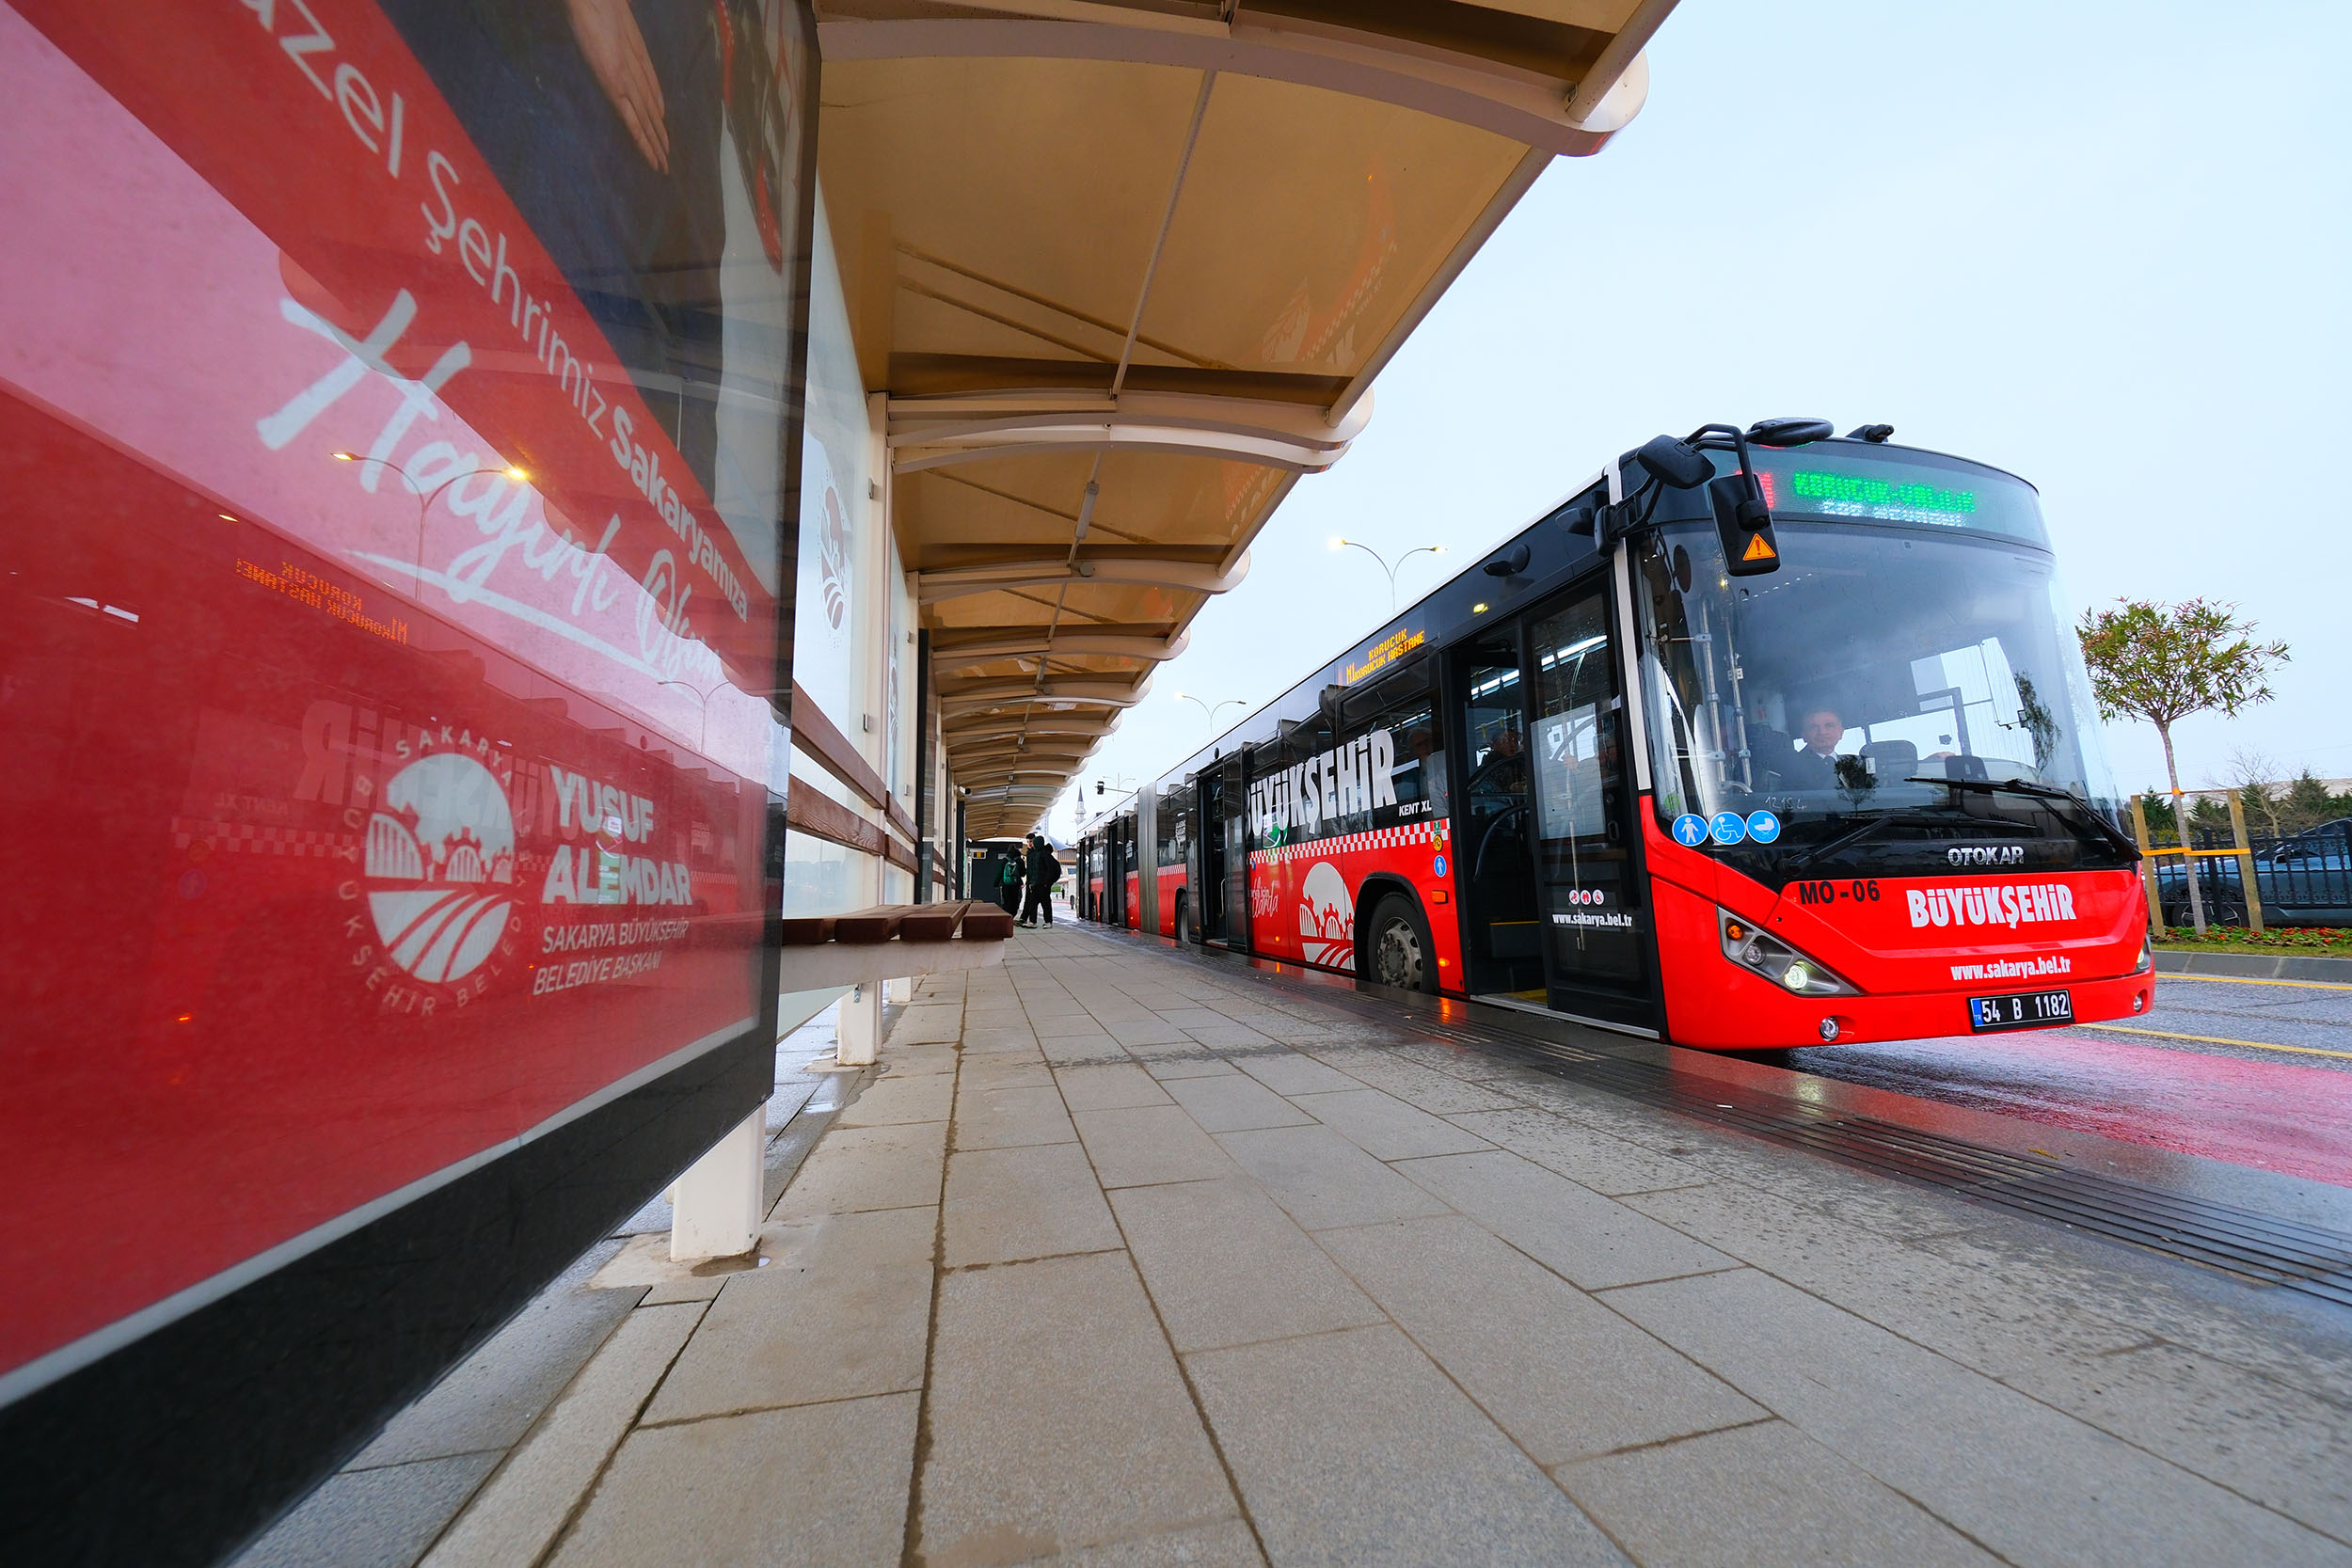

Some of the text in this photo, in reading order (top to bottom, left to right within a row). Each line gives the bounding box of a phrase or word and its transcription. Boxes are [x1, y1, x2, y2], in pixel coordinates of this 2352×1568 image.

[238, 0, 749, 624] zel Şehrimiz Sakaryamıza
[1368, 627, 1407, 661] KORUCUK
[1388, 629, 1425, 662] HASTANE
[395, 726, 513, 787] SAKARYA
[549, 765, 655, 844] YUSUF
[1399, 800, 1432, 817] KENT XL
[1947, 846, 2024, 866] OTOKAR
[542, 844, 693, 906] ALEMDAR
[1552, 911, 1632, 927] www.sakarya.bel.tr
[1906, 884, 2077, 929] BÜYÜKŞEHİR
[542, 917, 690, 954] SAKARYA BÜYÜKŞEHİR
[532, 950, 663, 996] BELEDİYE BAŞKANI
[1950, 956, 2071, 981] www.sakarya.bel.tr
[1981, 1000, 2001, 1022] 54
[2011, 998, 2023, 1020] B
[2035, 993, 2069, 1018] 1182
